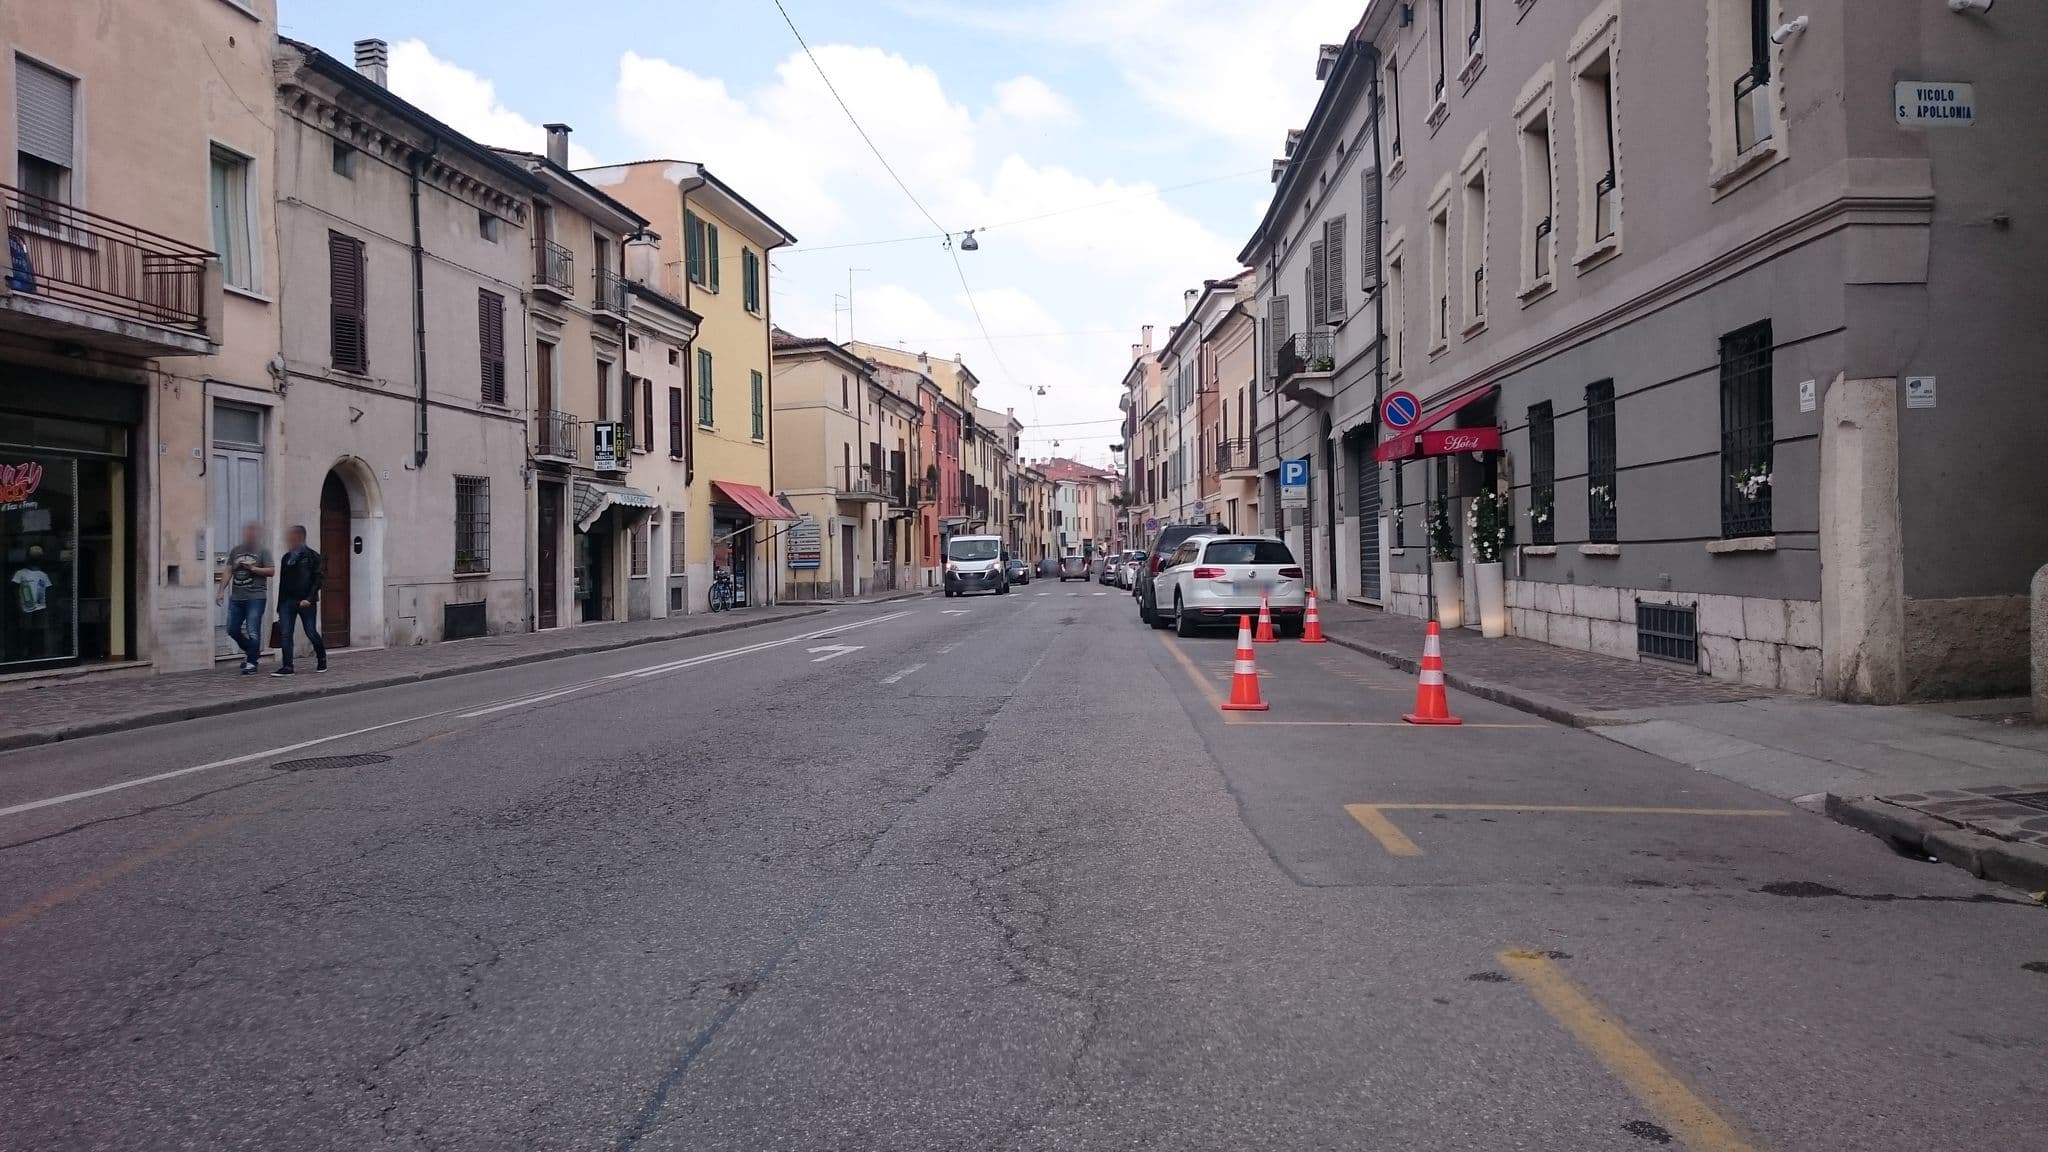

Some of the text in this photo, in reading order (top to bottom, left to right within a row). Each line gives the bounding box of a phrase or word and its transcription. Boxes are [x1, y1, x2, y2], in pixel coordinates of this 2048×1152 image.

[1917, 89, 1954, 101] VICOLO
[1899, 105, 1972, 118] S. APOLLONIA
[597, 426, 611, 451] T
[1443, 436, 1479, 450] Hotel
[1286, 463, 1303, 484] P
